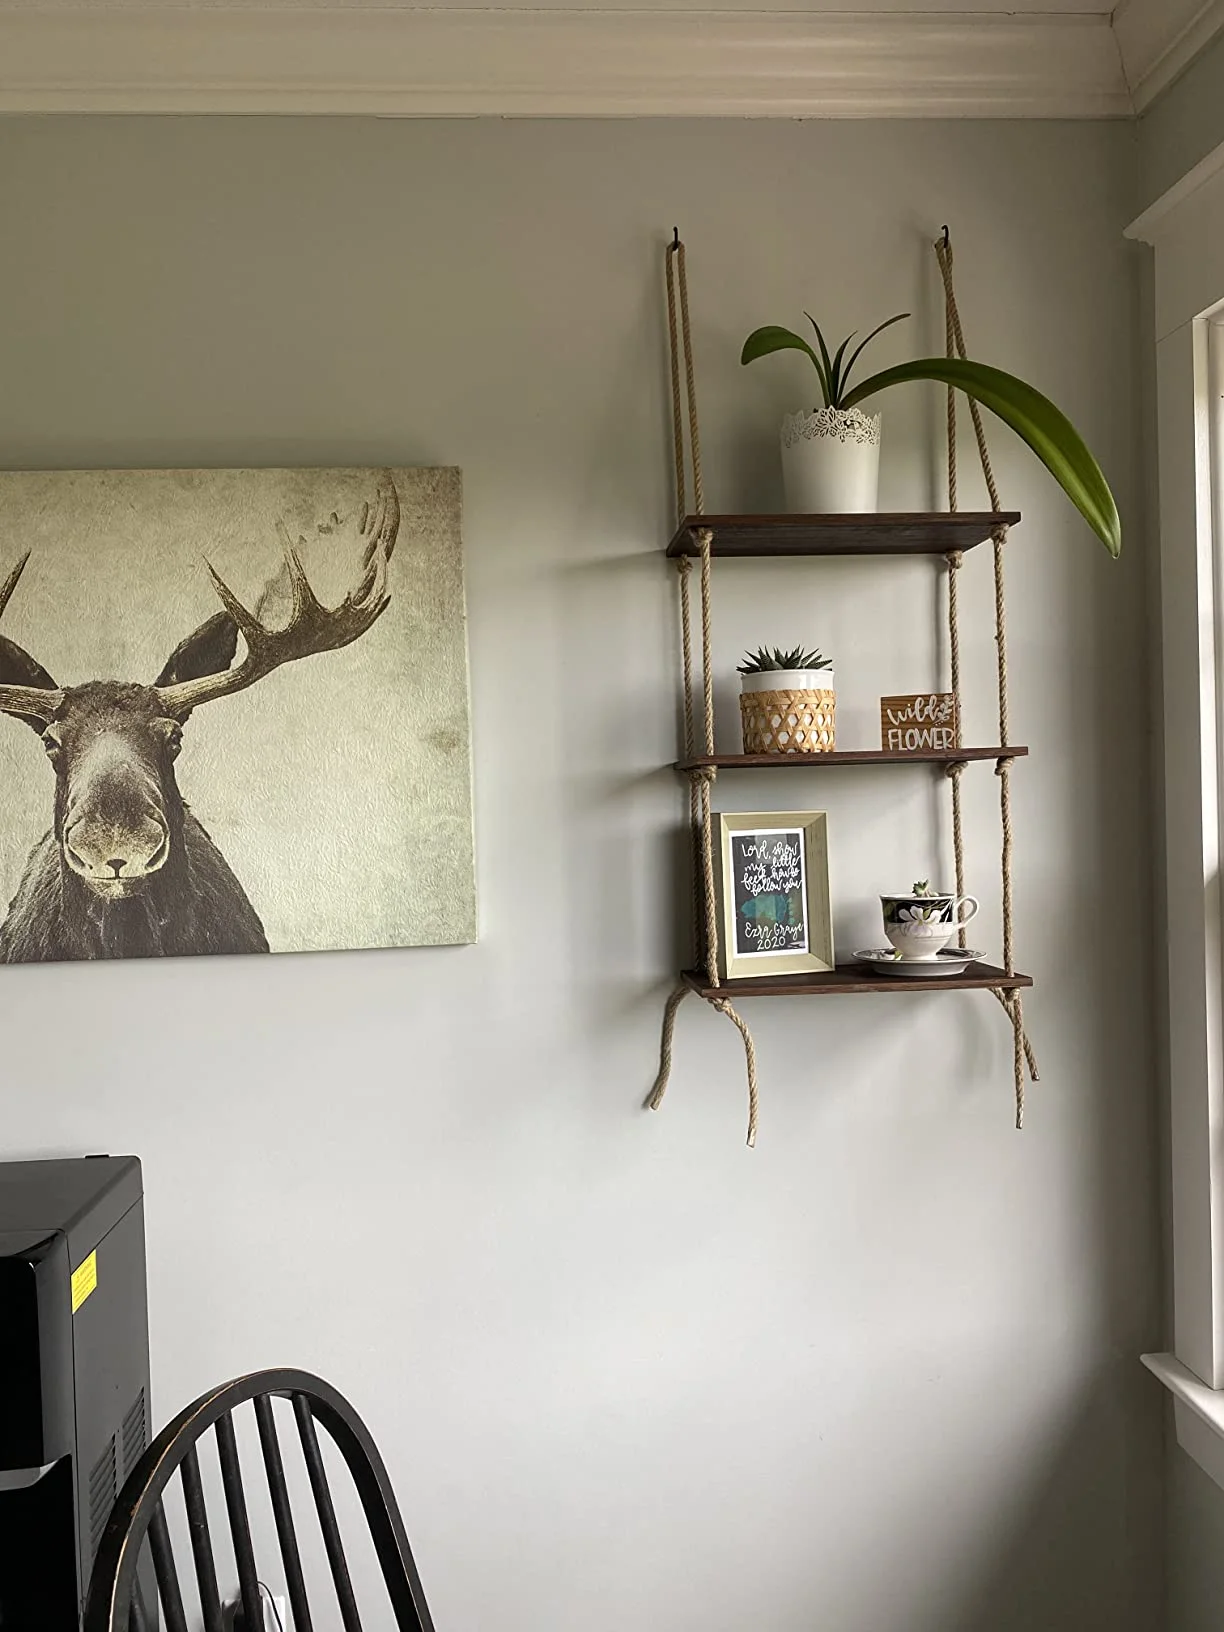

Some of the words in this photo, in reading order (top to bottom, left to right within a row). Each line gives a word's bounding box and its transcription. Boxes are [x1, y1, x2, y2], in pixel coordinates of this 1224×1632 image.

[887, 695, 939, 725] wild
[888, 728, 954, 750] FLOWER
[741, 840, 771, 859] Lord,
[772, 841, 798, 856] show
[744, 863, 766, 879] my
[770, 853, 801, 868] little
[741, 868, 766, 890] feet
[770, 867, 789, 881] how
[750, 877, 782, 896] follow
[783, 878, 802, 893] you
[745, 922, 772, 939] Ezra
[757, 936, 786, 951] 2020
